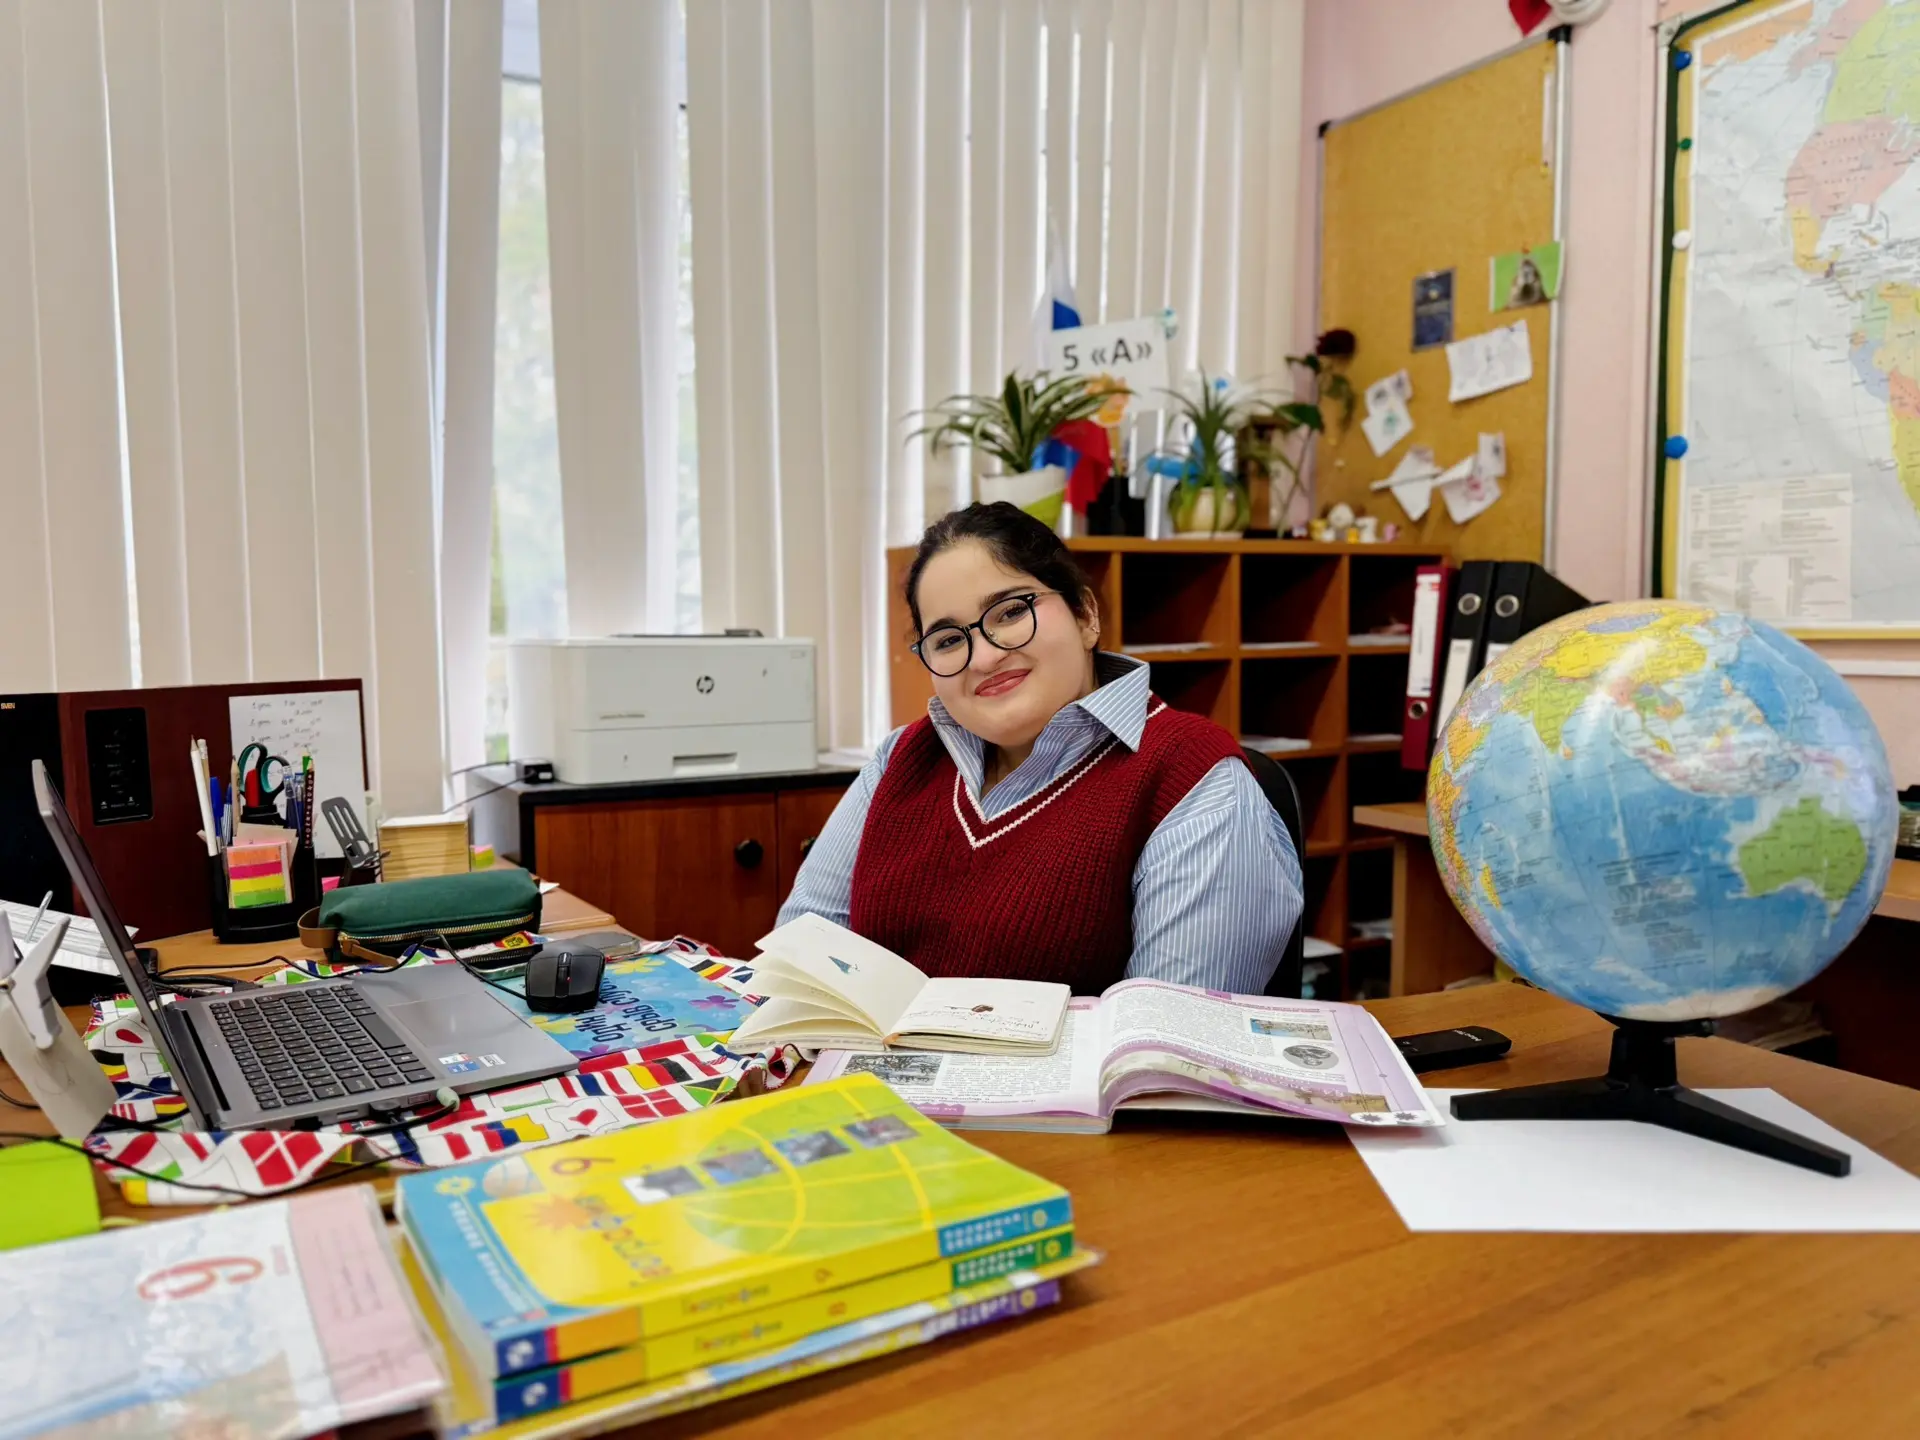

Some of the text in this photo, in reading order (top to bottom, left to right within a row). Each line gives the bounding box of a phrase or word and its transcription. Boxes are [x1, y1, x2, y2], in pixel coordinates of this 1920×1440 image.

[1063, 337, 1152, 372] 5 «А»
[1, 702, 16, 710] SVEN
